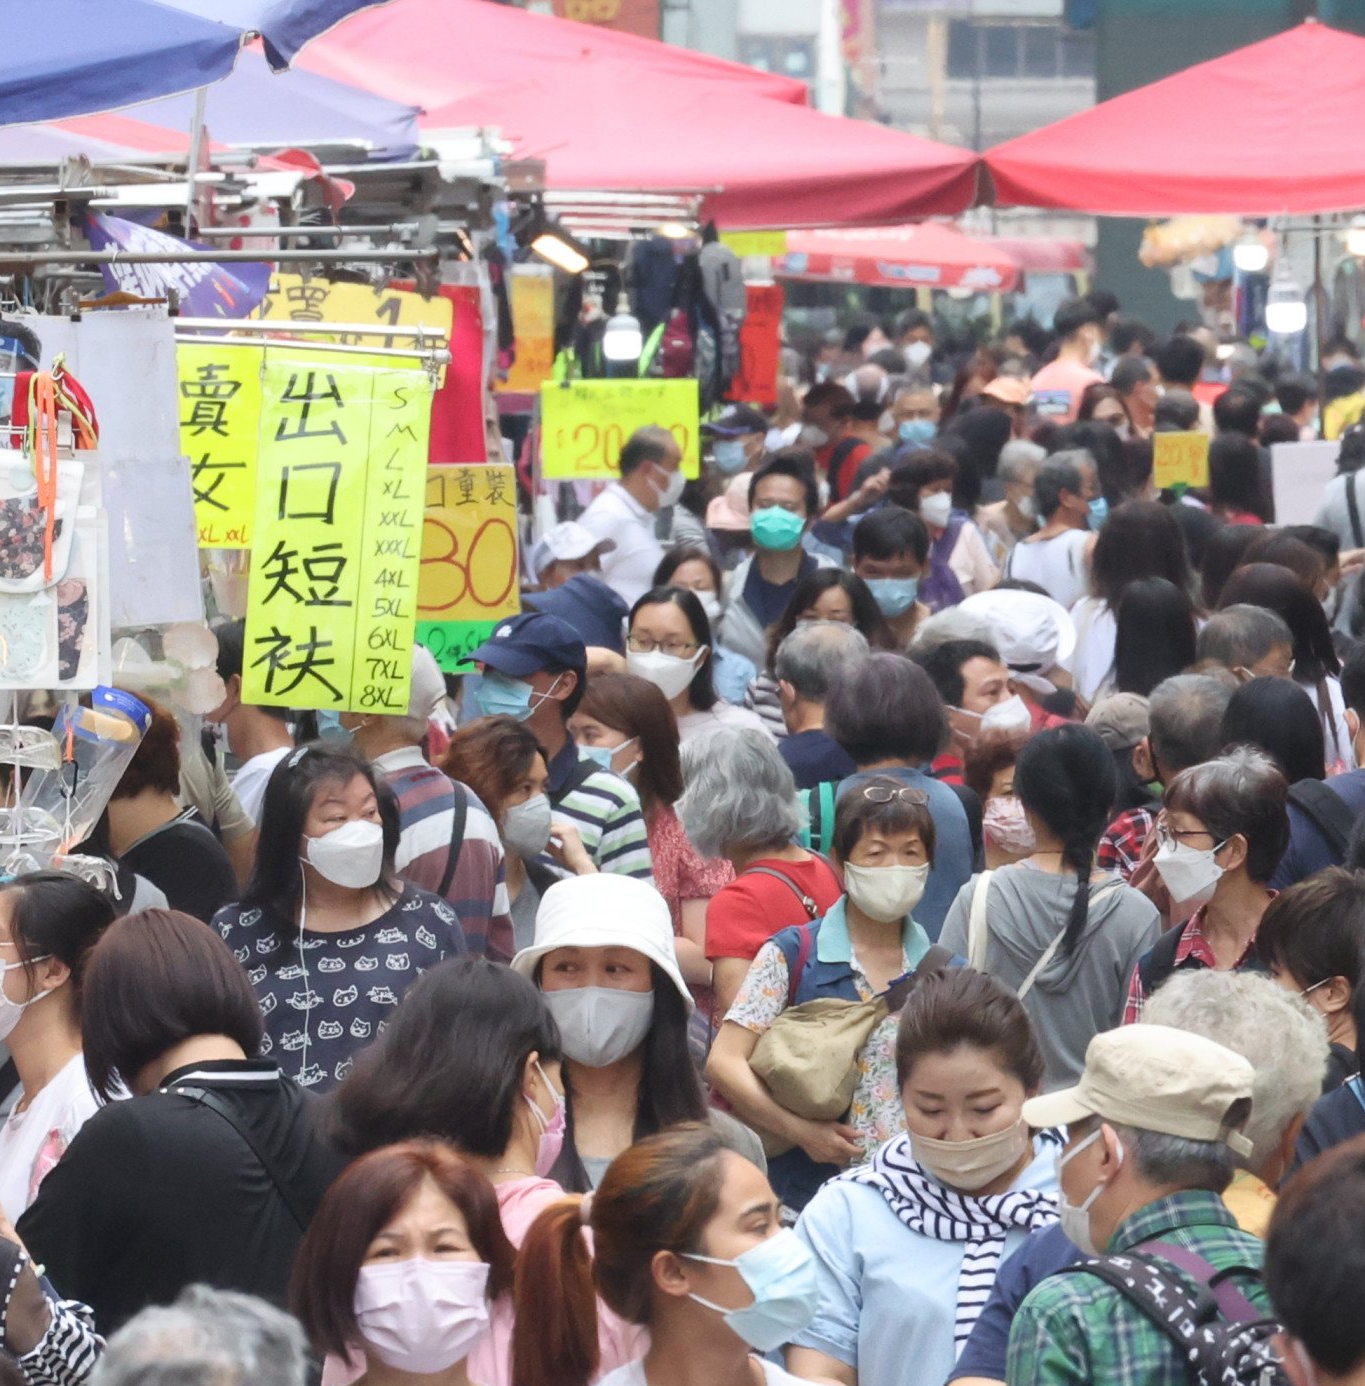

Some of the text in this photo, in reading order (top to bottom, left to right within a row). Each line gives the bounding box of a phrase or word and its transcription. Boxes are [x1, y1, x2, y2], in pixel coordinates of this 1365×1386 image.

[389, 387, 408, 409] S
[387, 423, 418, 442] M
[385, 448, 404, 471] L
[383, 480, 411, 498] XL
[378, 511, 415, 527] XXL
[375, 538, 416, 559] XXXL
[374, 569, 410, 588] 4XL
[371, 598, 410, 618] 5XL
[368, 626, 406, 651] 6XL
[366, 658, 404, 680] 7XL
[360, 685, 403, 708] 8XL
